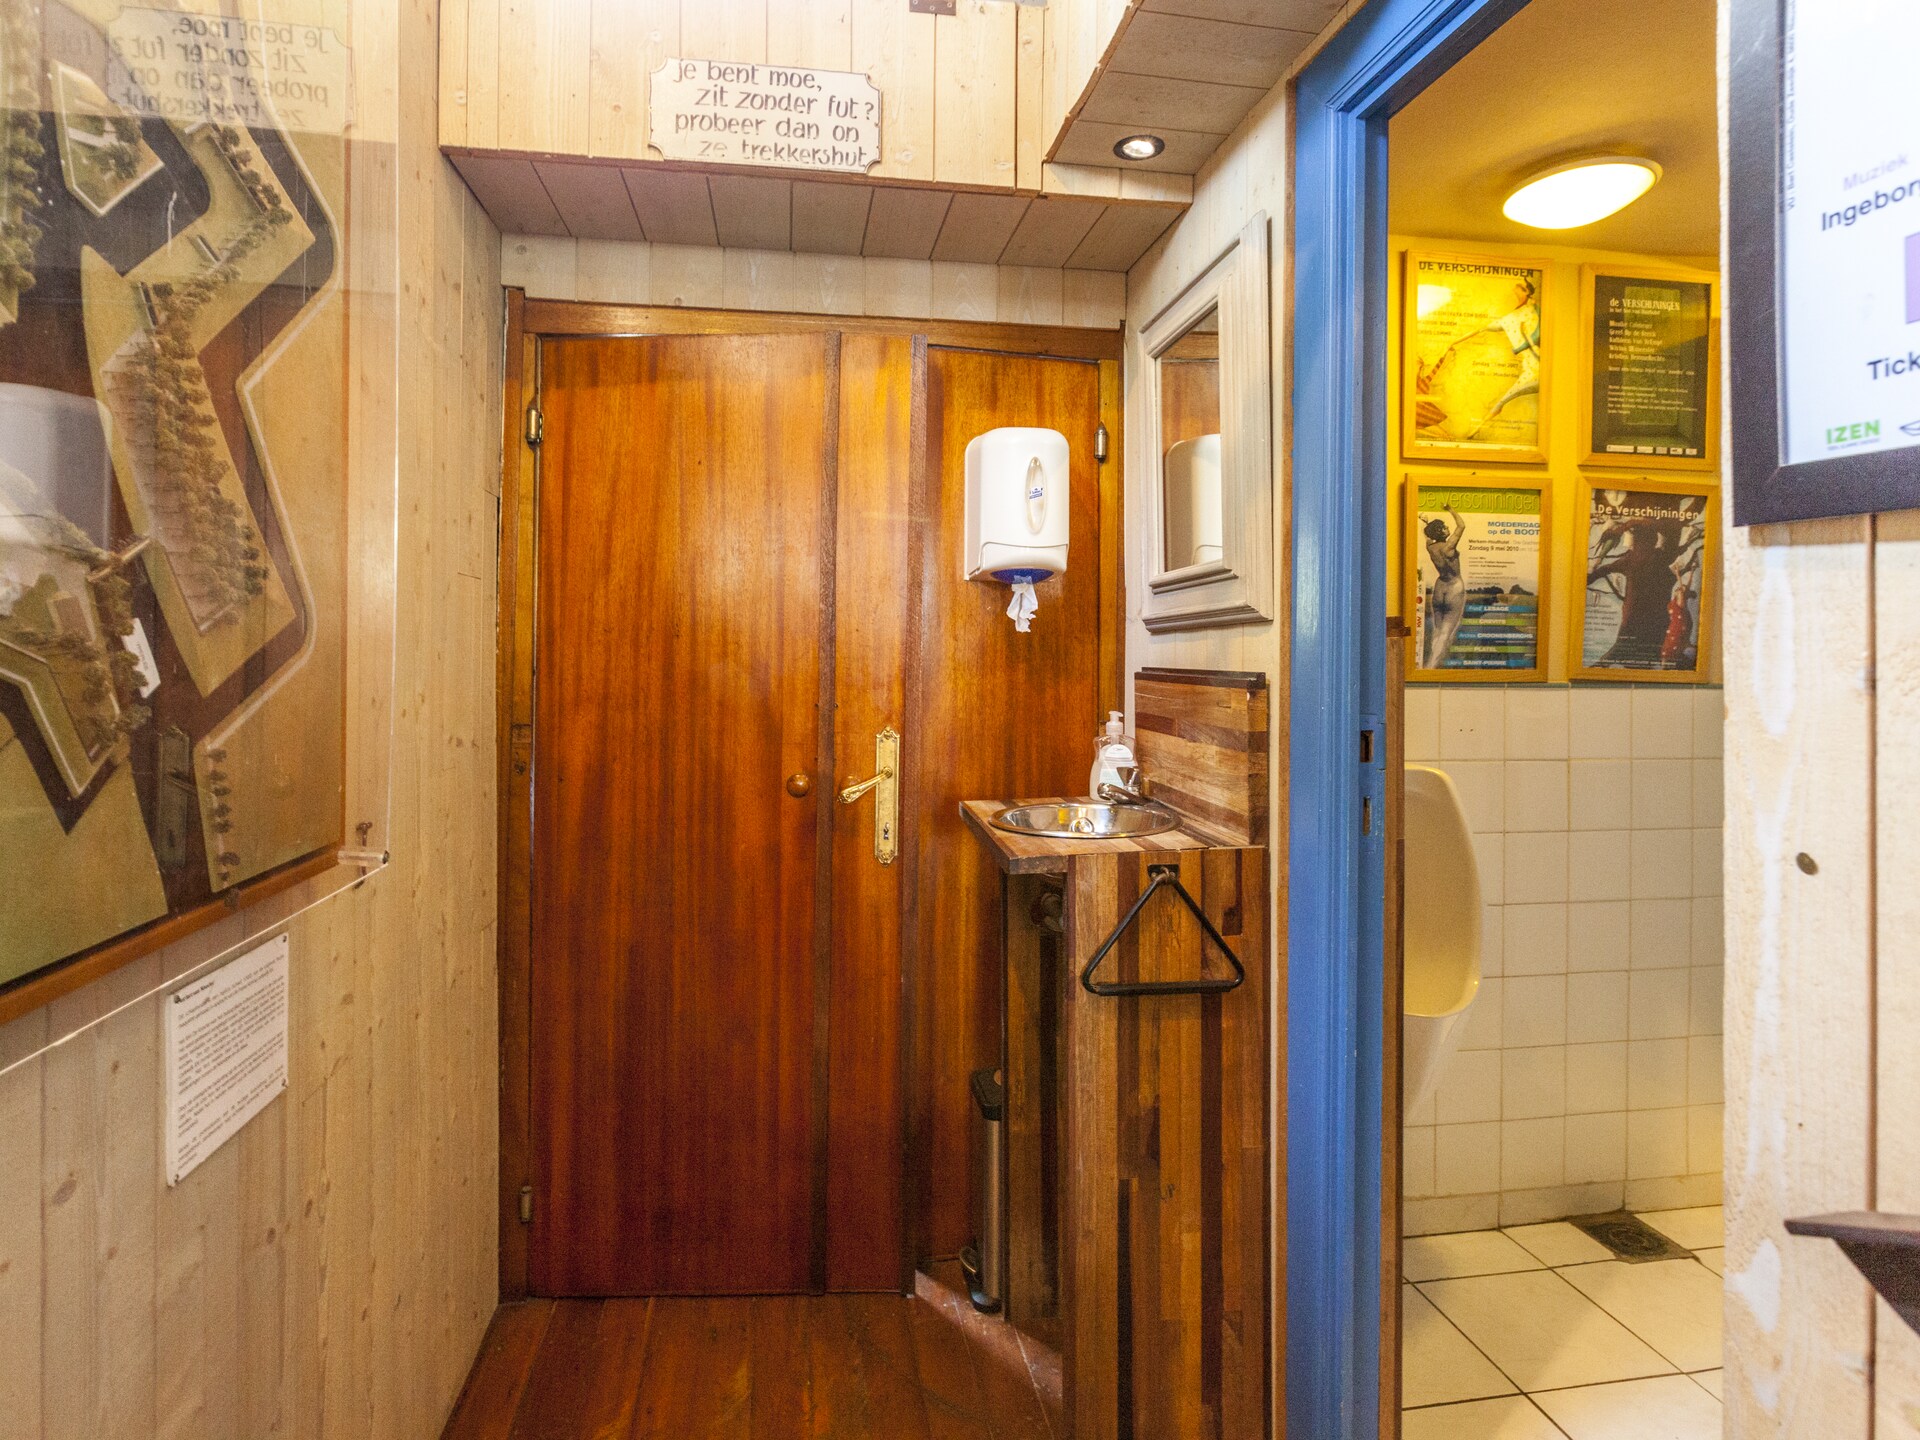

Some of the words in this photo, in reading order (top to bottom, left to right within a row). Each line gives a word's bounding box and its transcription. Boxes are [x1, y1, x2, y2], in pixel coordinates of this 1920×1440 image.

[673, 58, 697, 82] je
[707, 60, 760, 85] bent
[769, 69, 822, 92] moe,
[694, 84, 729, 107] zit
[735, 91, 818, 115] zonder
[675, 113, 767, 135] probeer
[776, 117, 820, 139] dan
[742, 139, 867, 168] trekkershut
[1843, 154, 1908, 191] Muziek
[1822, 179, 1920, 231] Ingebor
[1419, 261, 1434, 270] DE
[1438, 262, 1534, 278] VERSCHIJNINGEN
[1609, 297, 1620, 307] de
[1867, 351, 1920, 380] Tick
[1826, 419, 1880, 444] IZEN
[1598, 504, 1613, 514] De
[1616, 505, 1700, 521] Verschijningen
